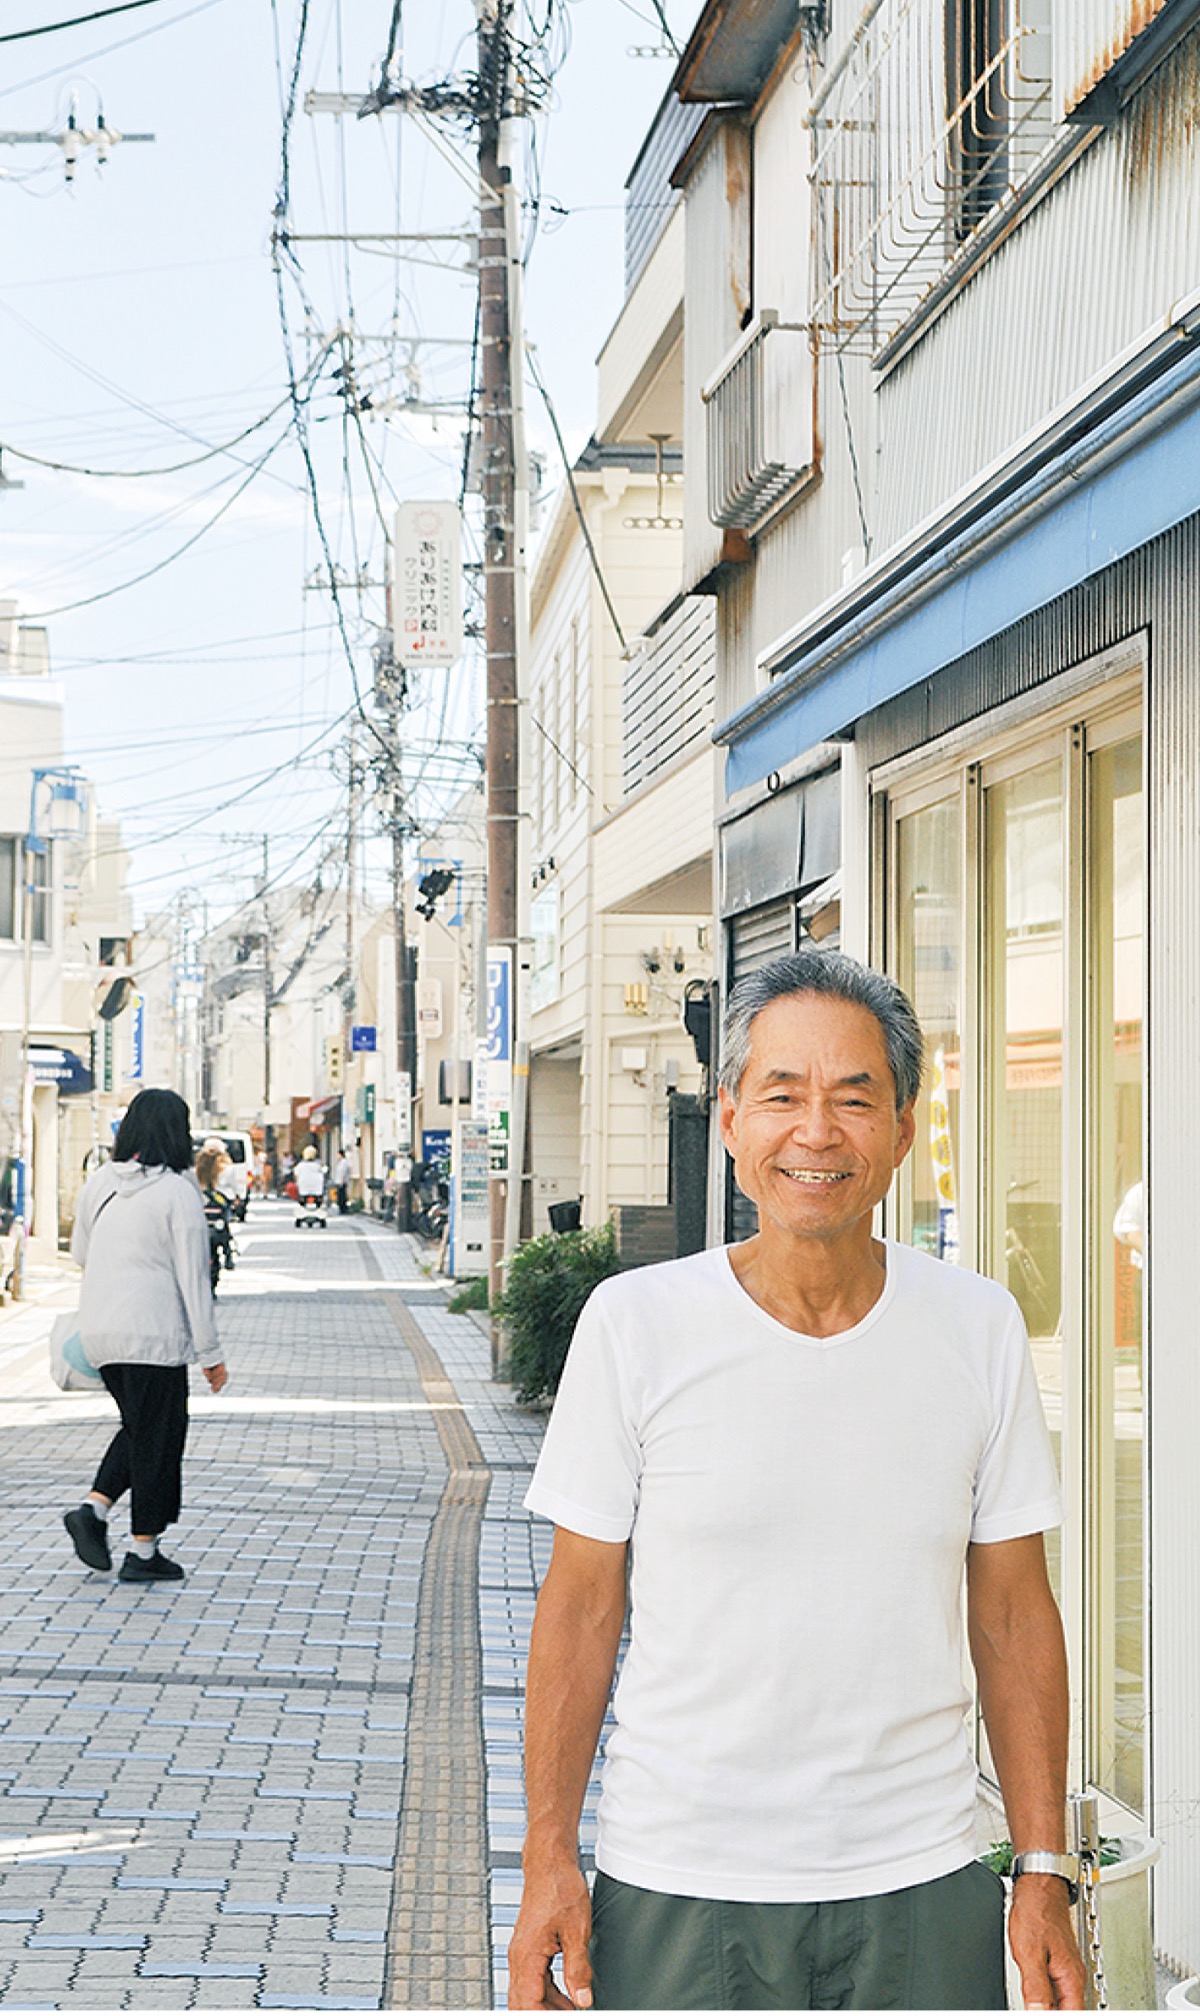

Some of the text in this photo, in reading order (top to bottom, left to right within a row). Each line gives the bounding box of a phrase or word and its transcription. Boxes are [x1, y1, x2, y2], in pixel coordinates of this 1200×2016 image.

[405, 557, 418, 617] クリニック
[419, 541, 437, 633] ありあけ内科
